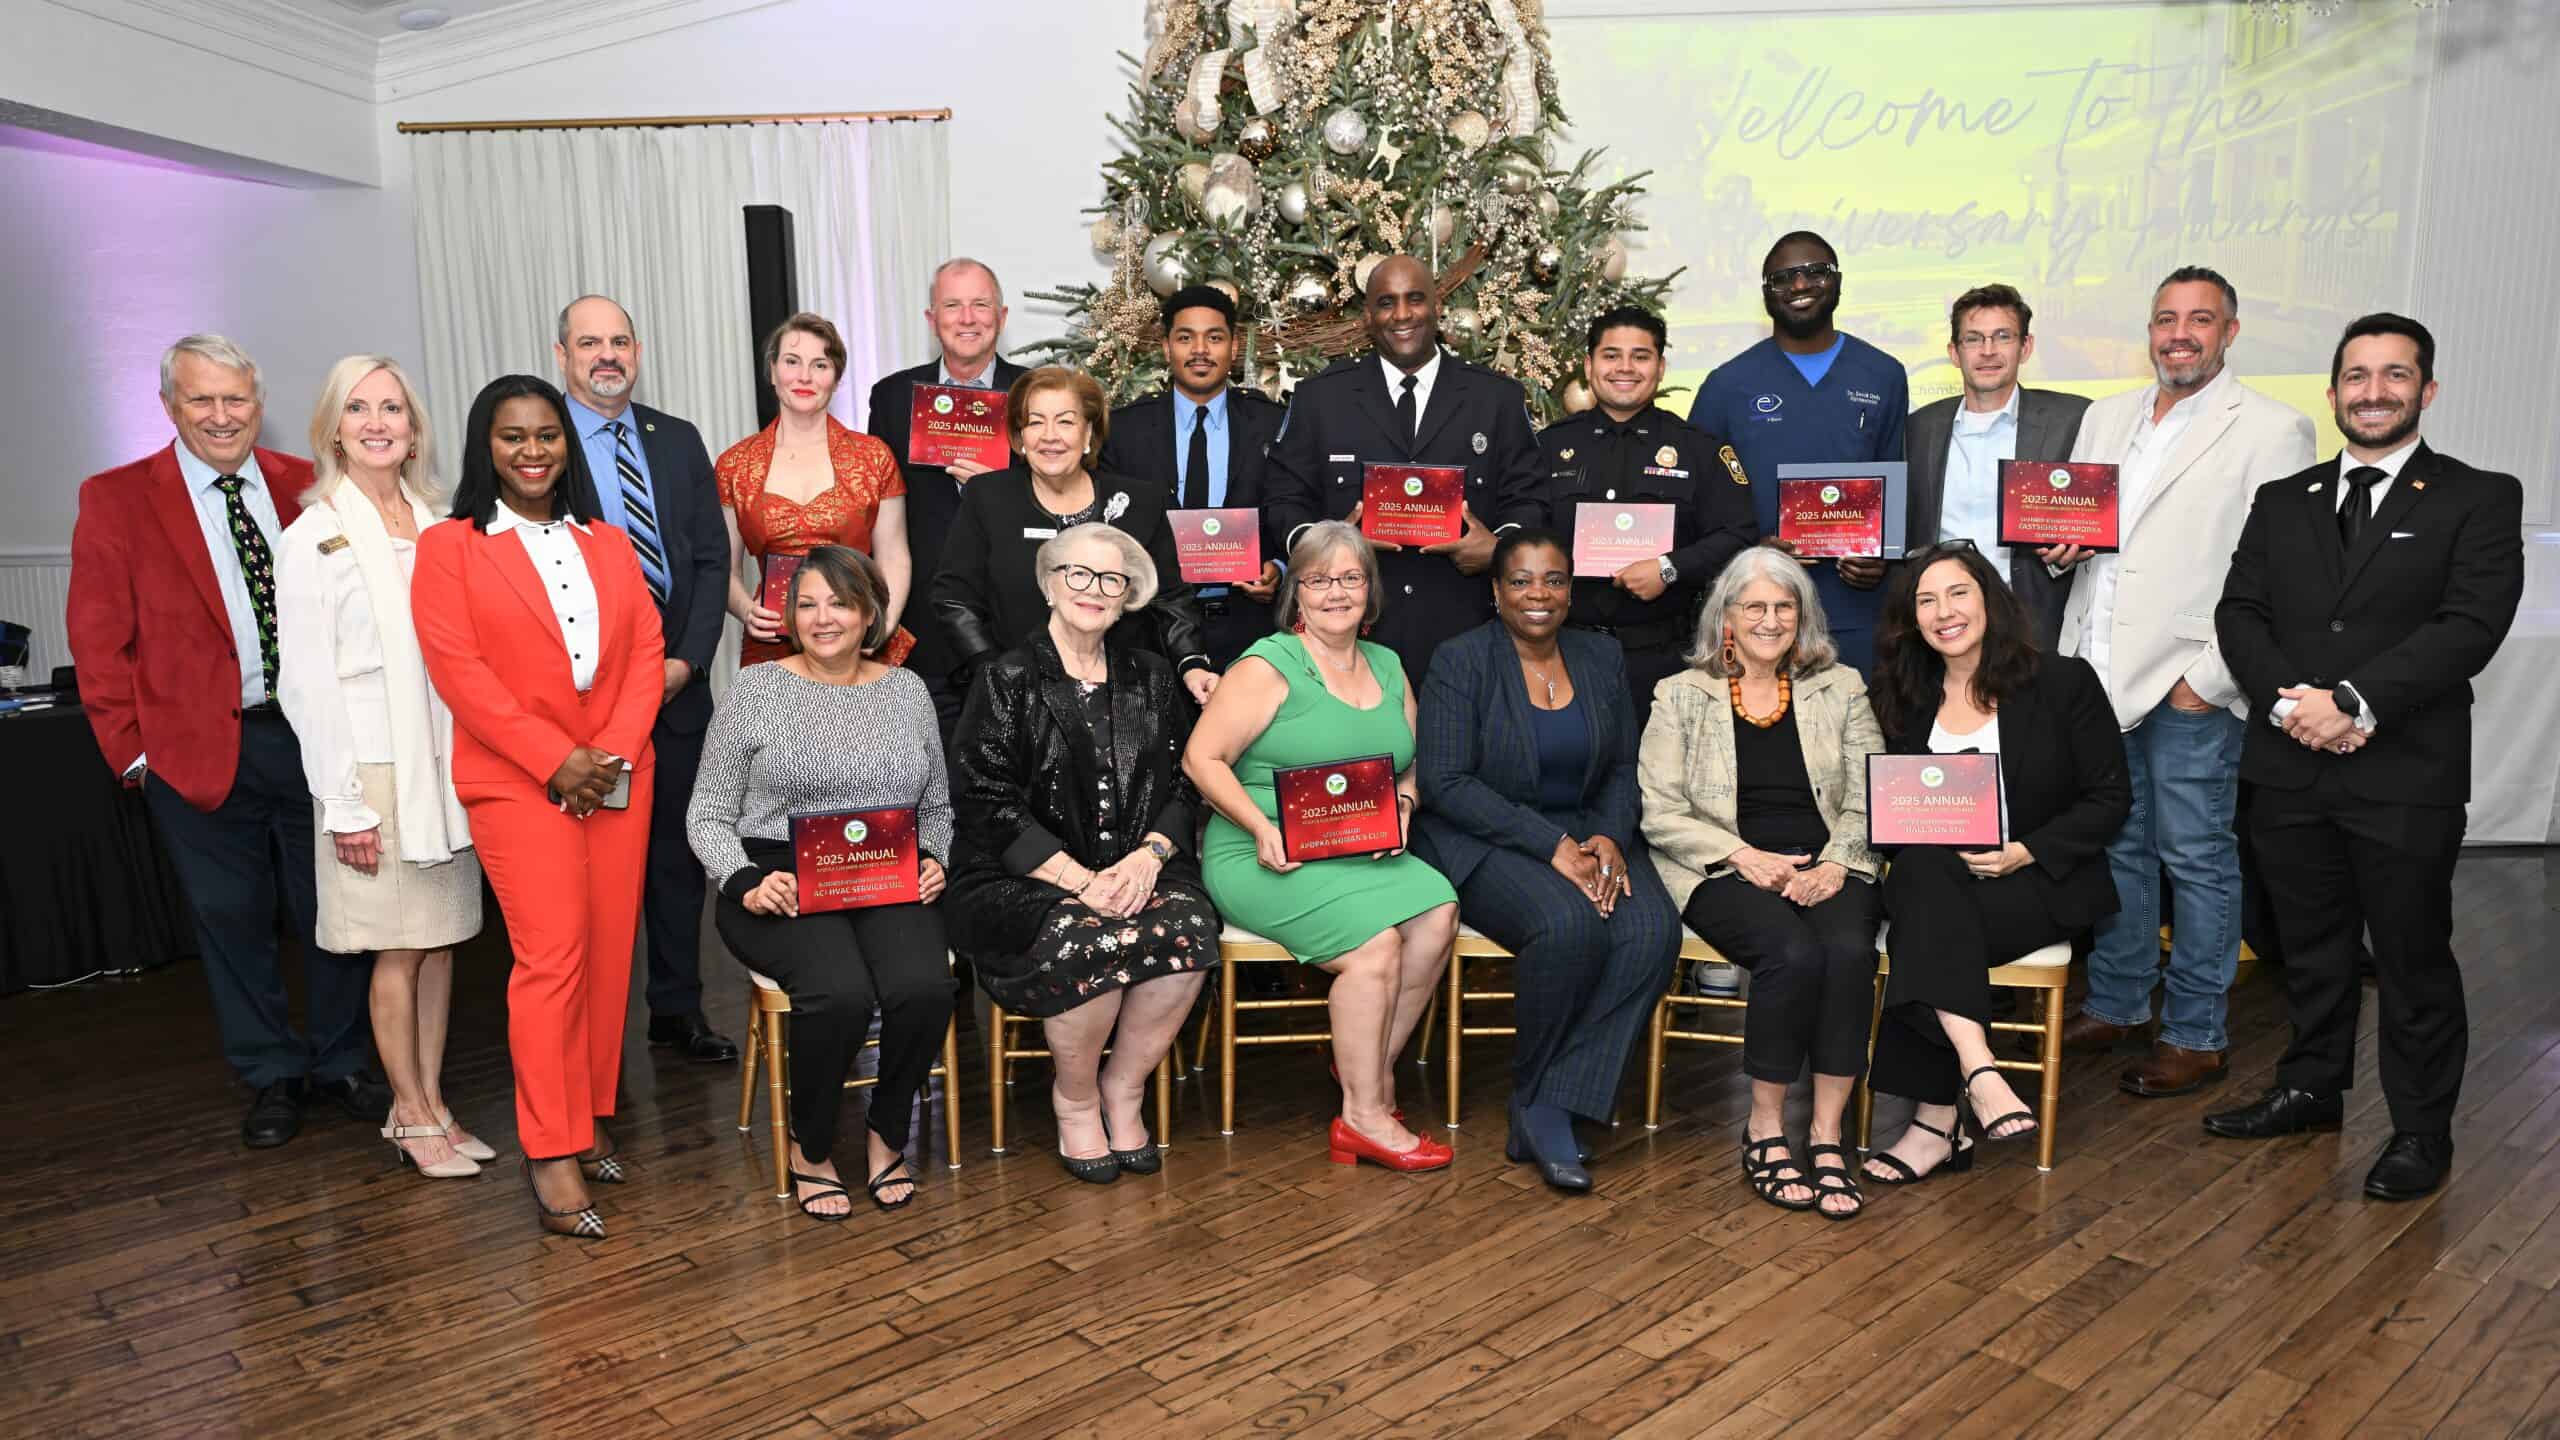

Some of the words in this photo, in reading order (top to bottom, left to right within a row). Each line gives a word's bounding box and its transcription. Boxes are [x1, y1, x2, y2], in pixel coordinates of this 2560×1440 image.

[928, 420, 951, 430] 2025
[954, 423, 995, 434] ANNUAL
[2021, 494, 2048, 504] 2025
[2050, 496, 2098, 506] ANNUAL
[1378, 502, 1402, 512] 2025
[1404, 503, 1446, 514] ANNUAL
[1796, 511, 1819, 520] 2025
[1822, 509, 1864, 520] ANNUAL
[1205, 541, 1245, 551] ANNUAL
[1923, 795, 1977, 806] ANNUAL
[1302, 806, 1328, 819] 2025
[1330, 800, 1377, 815] ANNUAL
[816, 853, 844, 866] 2025
[847, 847, 898, 863] ANNUAL
